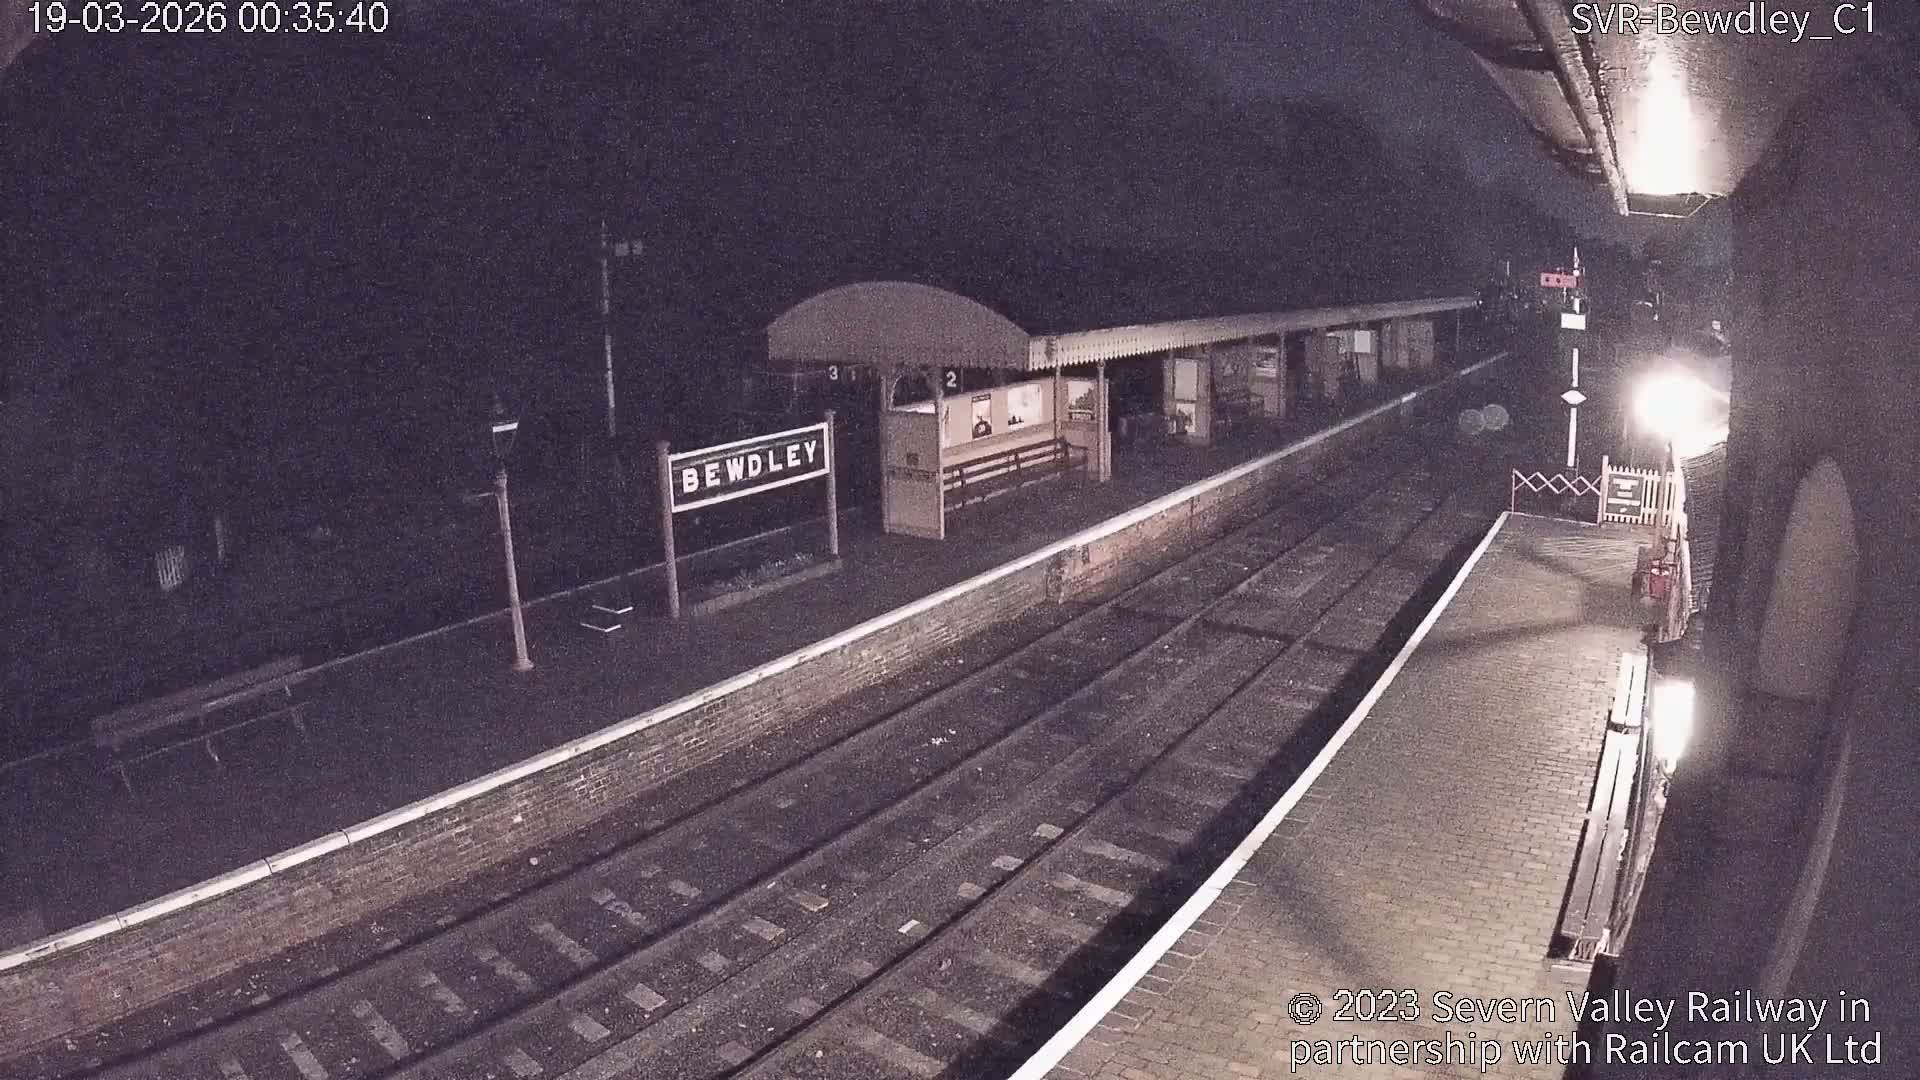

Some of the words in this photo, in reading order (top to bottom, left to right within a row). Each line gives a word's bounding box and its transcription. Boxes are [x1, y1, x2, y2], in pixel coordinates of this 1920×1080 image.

[828, 365, 839, 381] 3
[946, 371, 957, 388] 2
[682, 440, 817, 494] BEWDLEY
